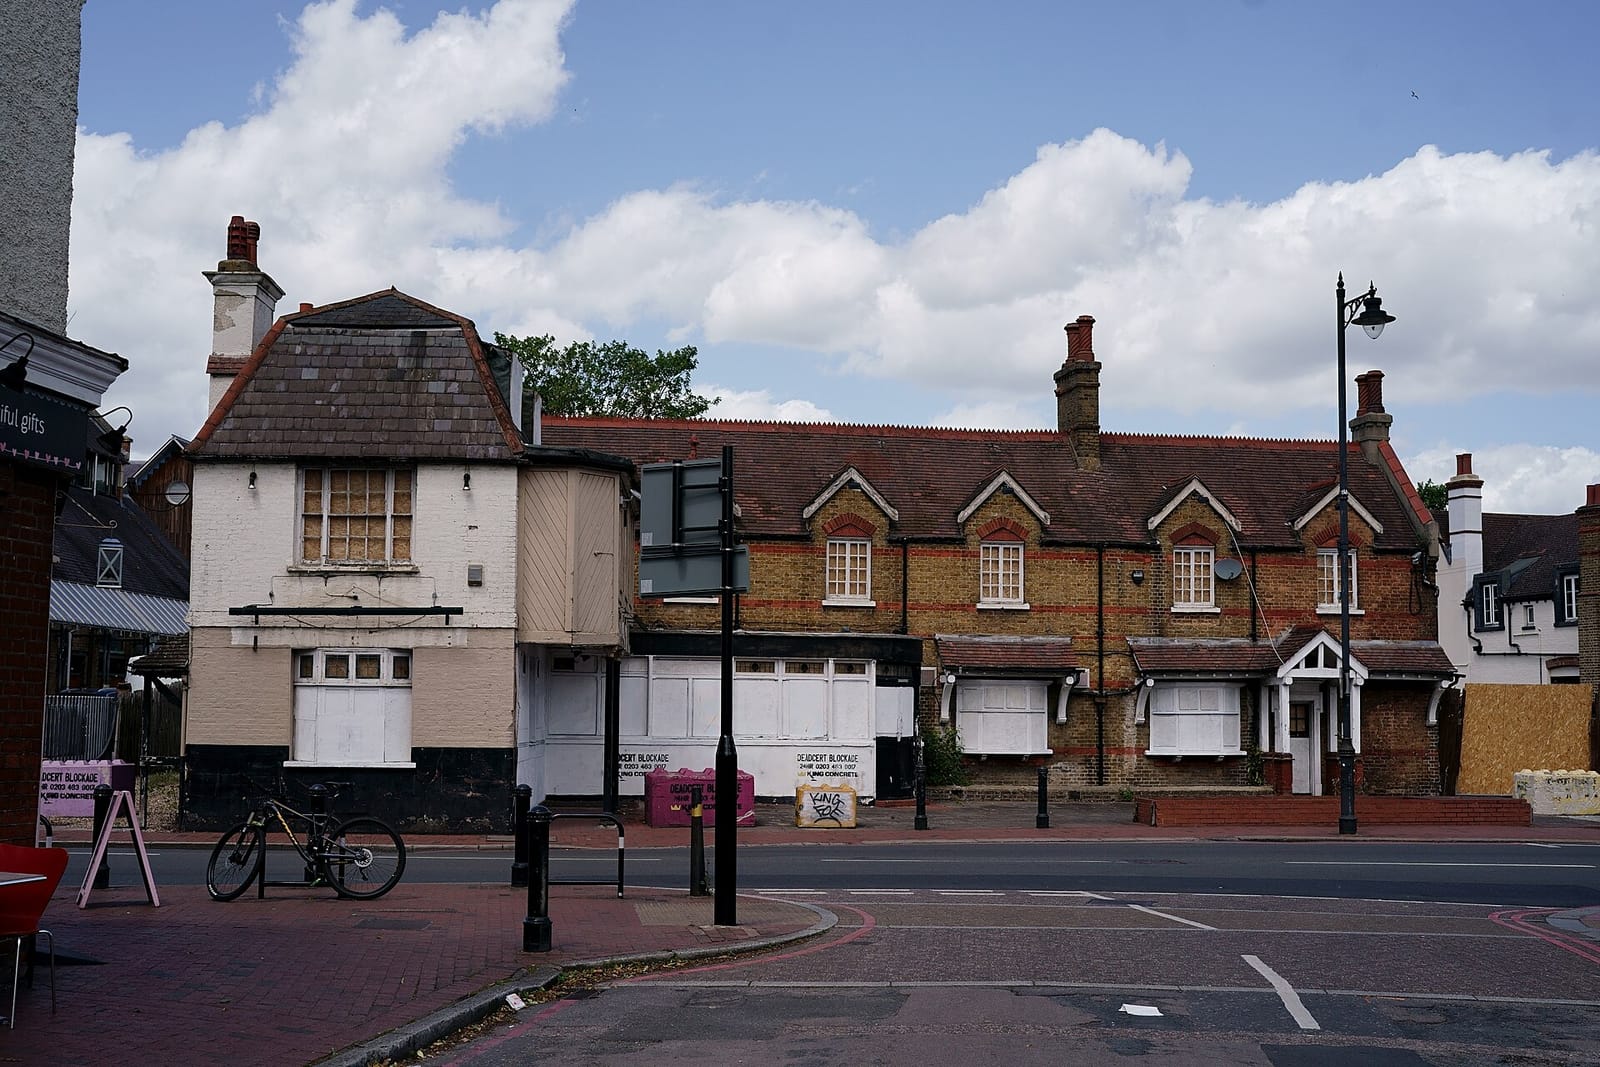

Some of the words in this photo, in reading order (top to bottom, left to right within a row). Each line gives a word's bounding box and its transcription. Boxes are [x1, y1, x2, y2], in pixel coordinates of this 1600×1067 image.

[20, 412, 45, 434] gifts
[638, 754, 669, 762] BLOCKADE
[797, 753, 827, 762] DEADCERT
[829, 754, 859, 762] BLOCKADE
[65, 773, 98, 782] BLOCKADE
[807, 771, 824, 779] KING
[809, 793, 844, 806] KING
